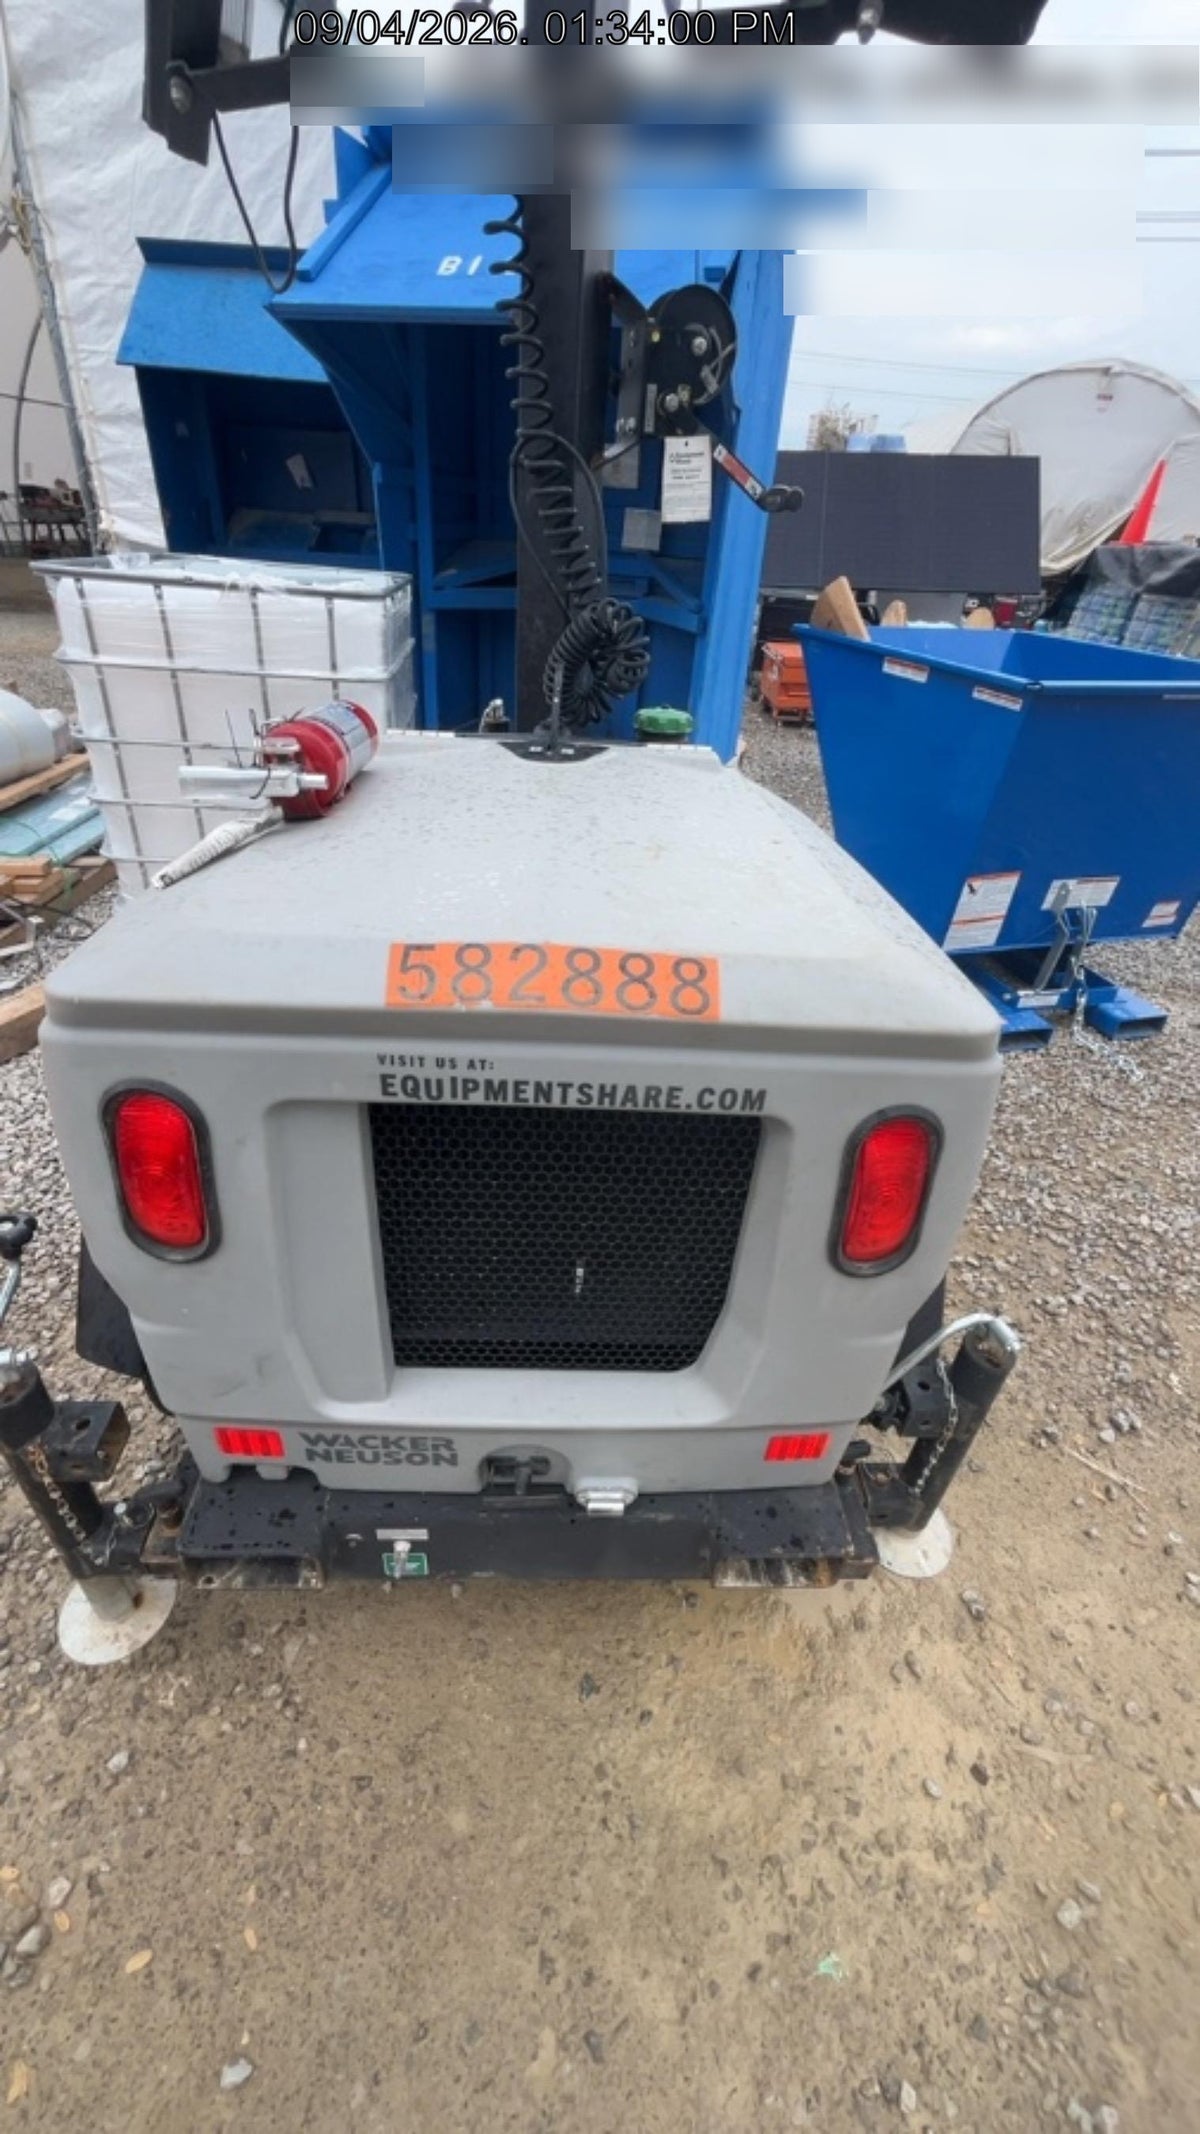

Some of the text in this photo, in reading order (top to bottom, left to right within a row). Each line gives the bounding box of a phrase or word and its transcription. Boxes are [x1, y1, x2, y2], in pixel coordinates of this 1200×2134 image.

[397, 943, 711, 1016] 582888
[377, 1053, 495, 1071] VISIT US AT:
[379, 1073, 768, 1112] EQUIPMENTSHARE.COM
[298, 1432, 455, 1452] WACKER
[304, 1448, 459, 1467] NEUSON
